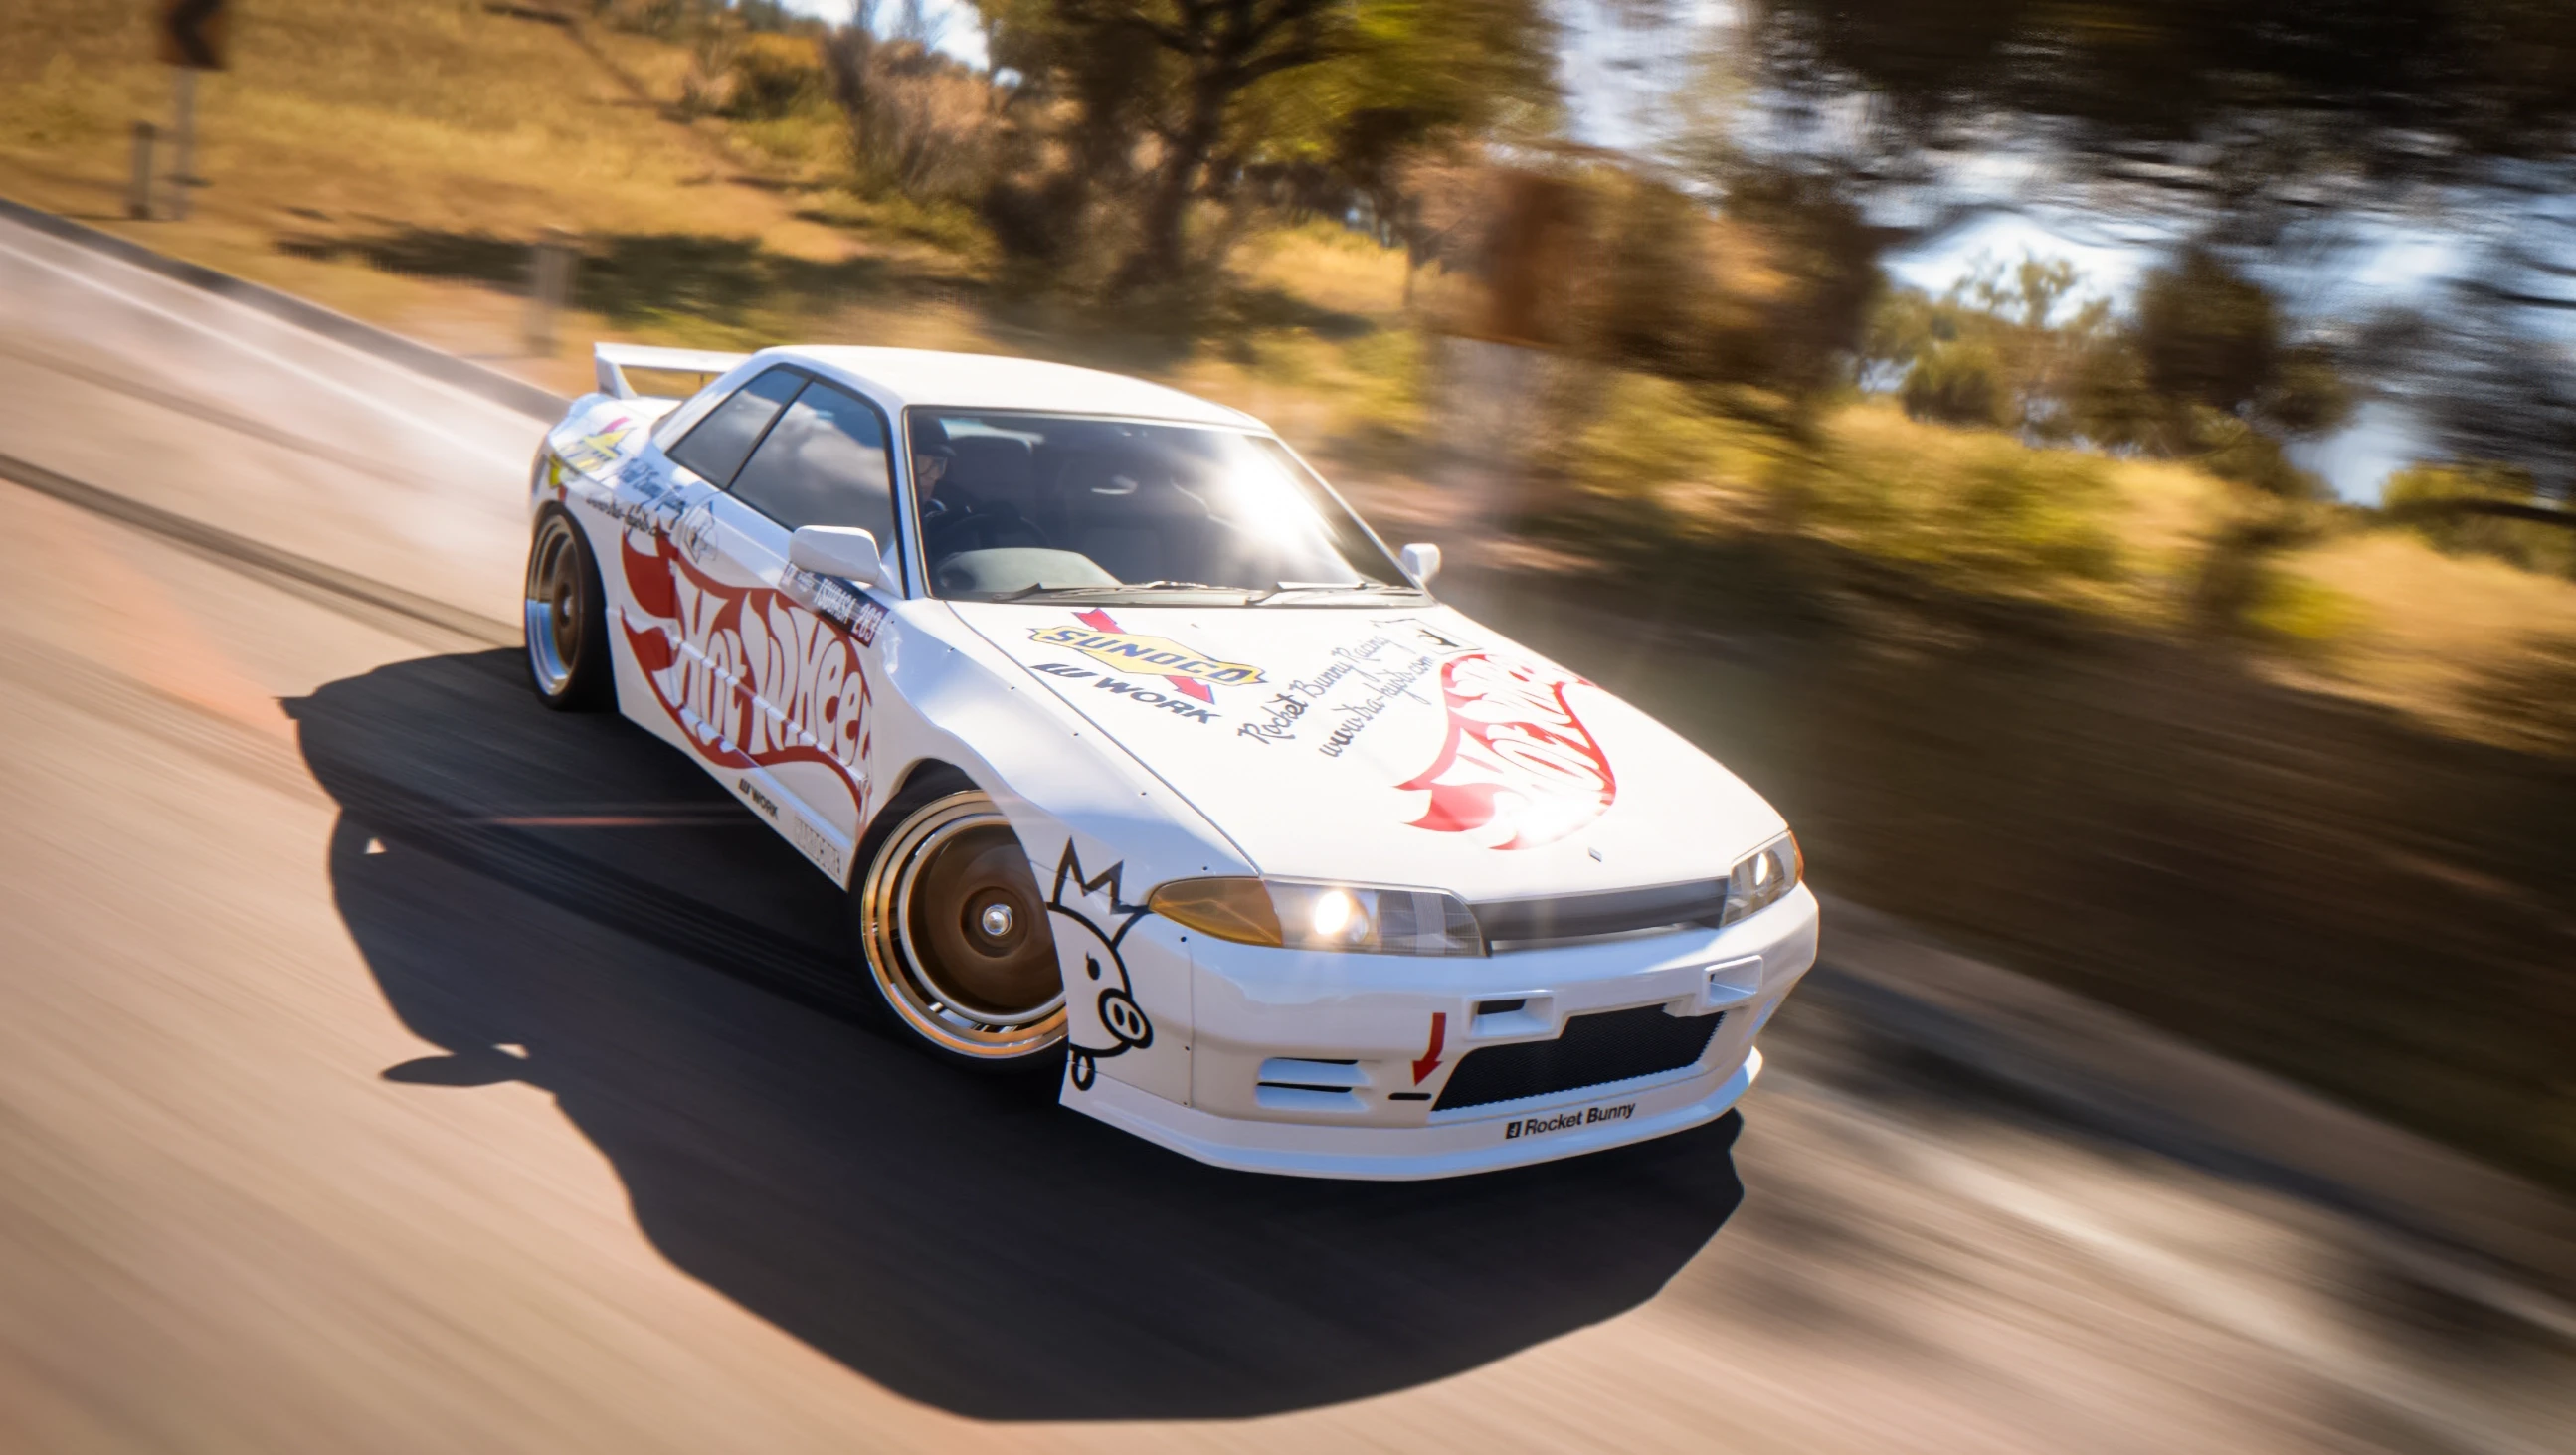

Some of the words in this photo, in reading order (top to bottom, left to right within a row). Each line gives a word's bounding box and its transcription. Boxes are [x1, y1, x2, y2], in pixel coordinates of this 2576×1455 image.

[1042, 629, 1254, 682] SUNOCO
[1331, 634, 1417, 664] Racing
[740, 589, 873, 768] Wheel
[1093, 677, 1223, 724] WORK
[1288, 661, 1381, 699] Bunny
[1236, 693, 1309, 745] Rocket
[1523, 1111, 1583, 1137] Rocket
[1586, 1102, 1637, 1125] Bunny
